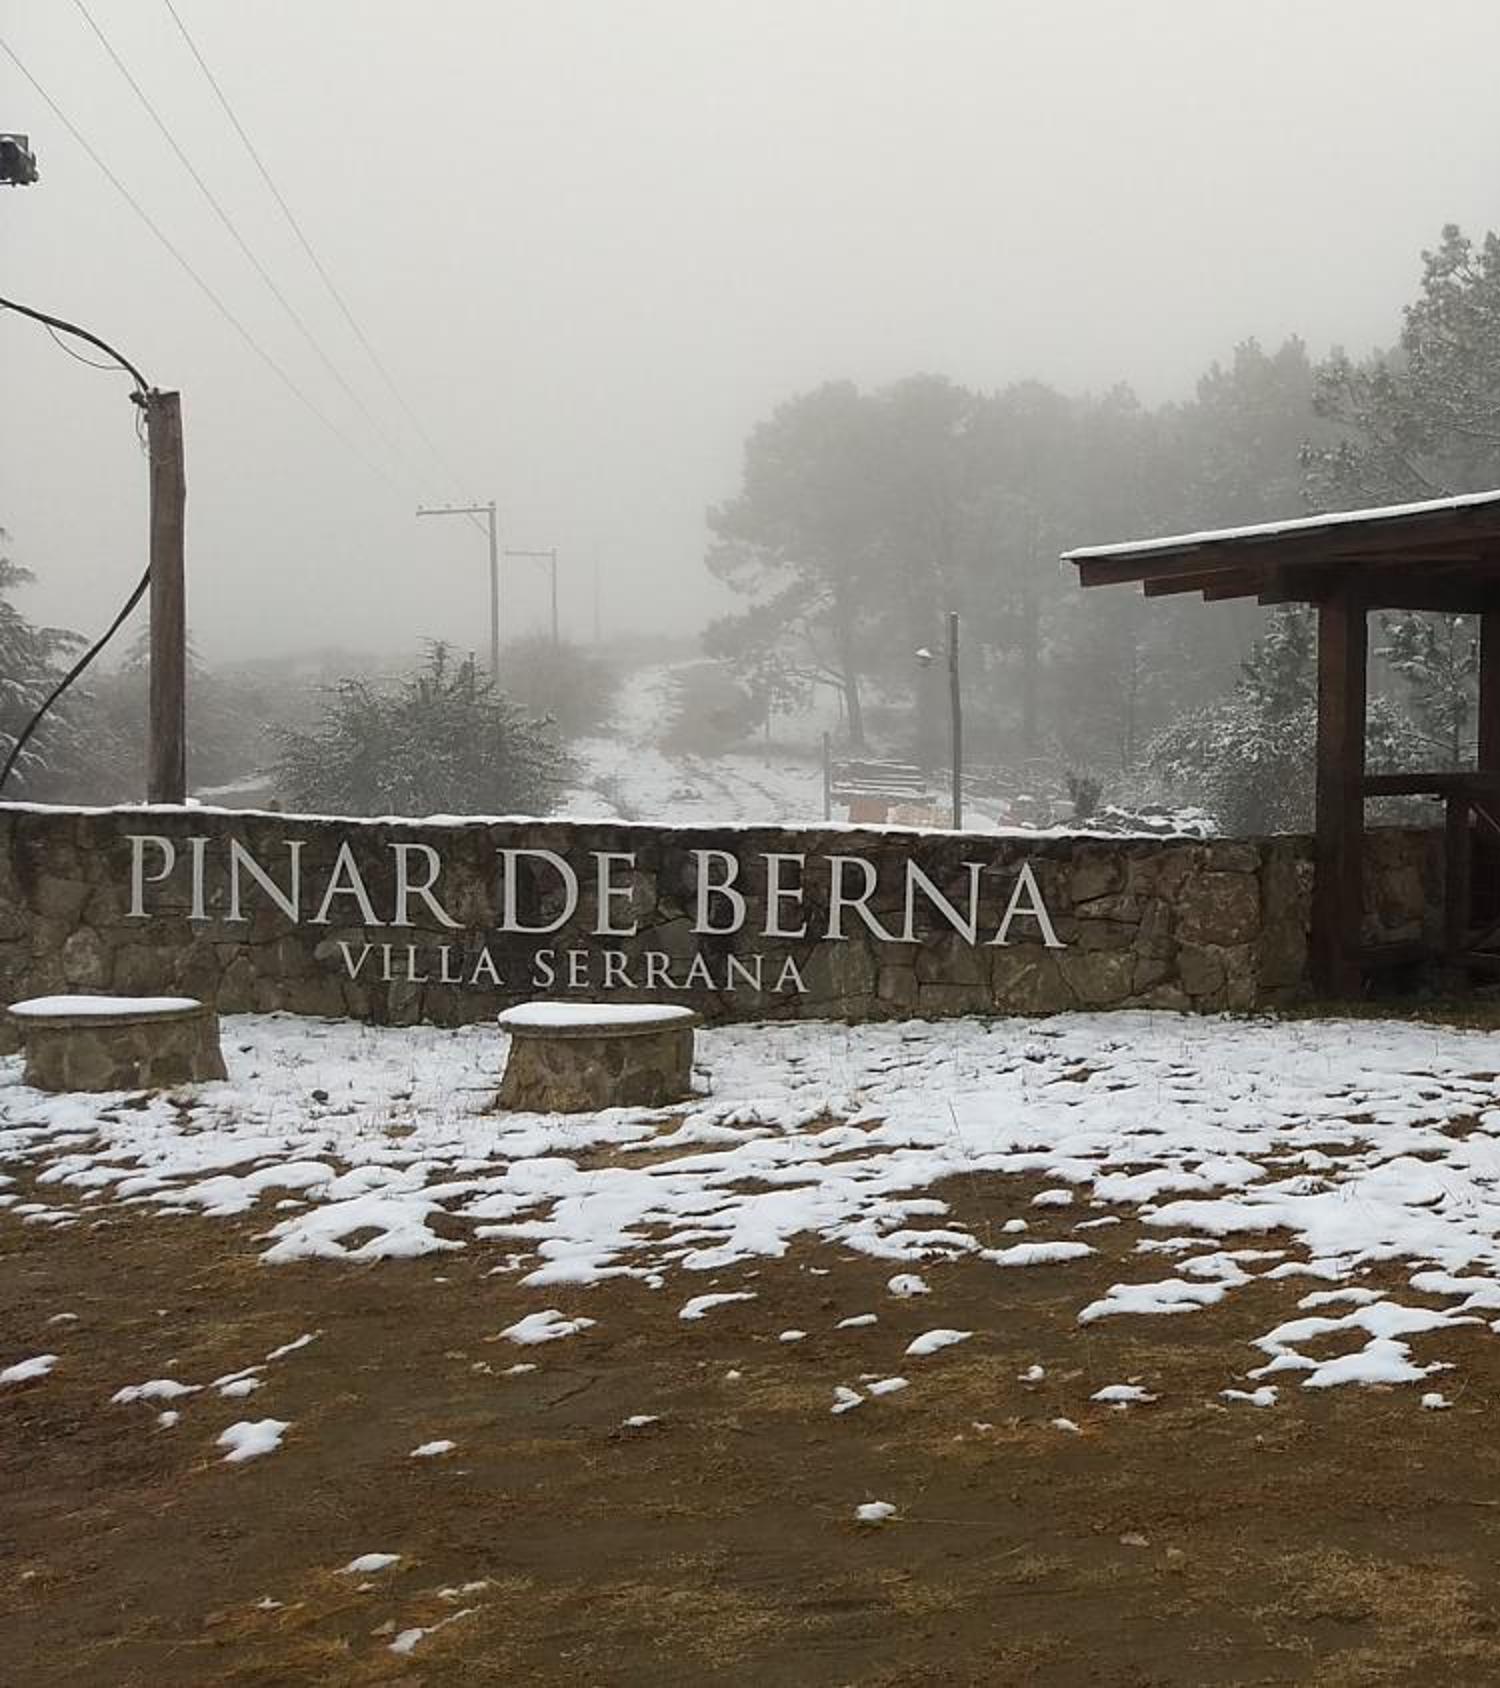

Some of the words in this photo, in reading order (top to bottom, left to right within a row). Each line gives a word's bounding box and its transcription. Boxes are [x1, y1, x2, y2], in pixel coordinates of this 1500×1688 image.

[124, 835, 466, 928] PINAR
[496, 848, 638, 936] DE
[688, 849, 1067, 949] BERNA
[337, 941, 505, 985] VILLA
[532, 948, 810, 993] SERRANA
